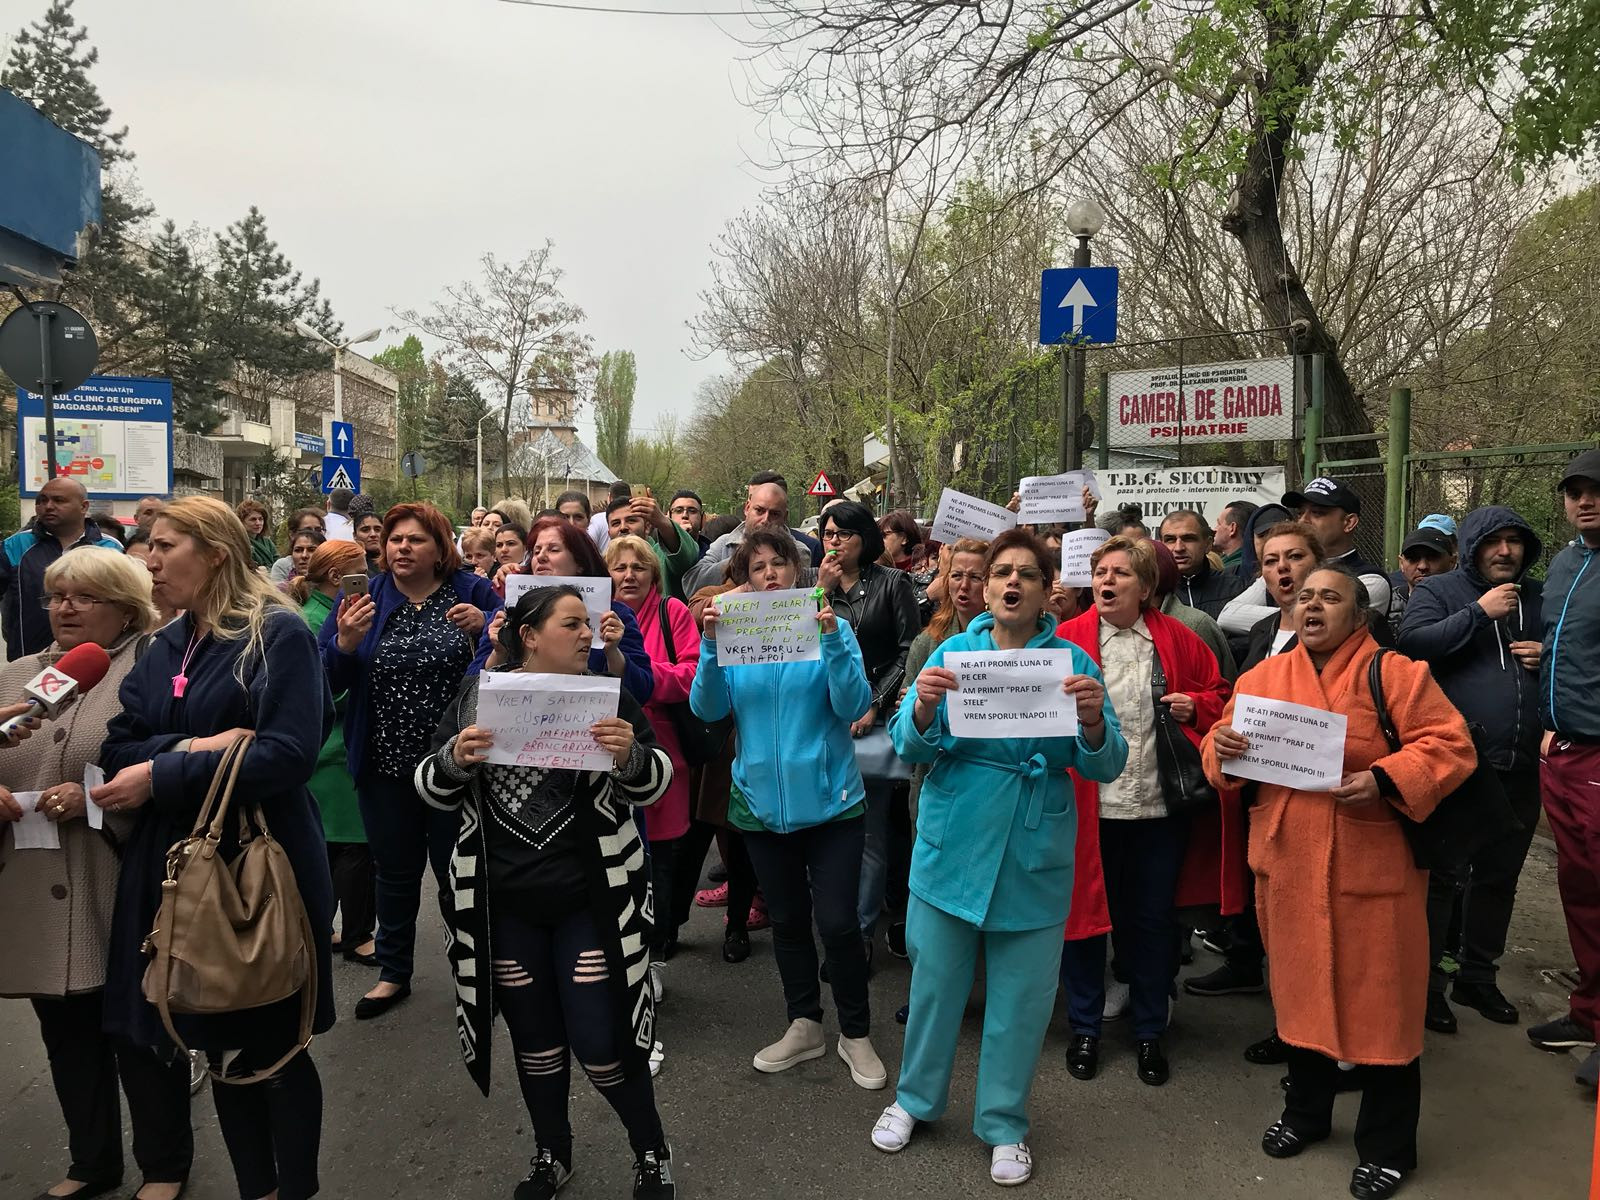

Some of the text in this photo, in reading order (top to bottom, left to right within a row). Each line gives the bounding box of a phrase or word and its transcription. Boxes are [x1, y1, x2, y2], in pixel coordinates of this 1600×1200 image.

[1212, 368, 1248, 376] PSIHIATRIE
[1182, 378, 1218, 386] ALEXANDRU
[74, 394, 105, 403] CLINIC
[106, 396, 119, 404] DE
[1120, 384, 1283, 426] CAMERA DE GARDA
[1150, 422, 1248, 438] PSIHIATRIE
[1108, 470, 1266, 486] T.B.G. SECURITY
[1146, 486, 1180, 494] protectie
[1232, 486, 1258, 494] rapida
[951, 498, 967, 507] NE-ATI
[967, 504, 986, 514] PROMIS
[987, 510, 1000, 518] LUNA
[955, 517, 972, 526] PRIMIT
[724, 600, 760, 614] VREM
[725, 645, 806, 654] VREM SPORUL
[961, 661, 986, 669] NE-ATI
[496, 693, 533, 707] VREM
[1246, 706, 1329, 729] NE-ATI PROMIS LUNA DE
[1253, 720, 1266, 728] CER
[1242, 730, 1315, 750] AM PRIMIT "PRAF DE
[1248, 743, 1264, 751] ELE"
[1238, 754, 1325, 778] VREM SPORUL INAPOI !!!
